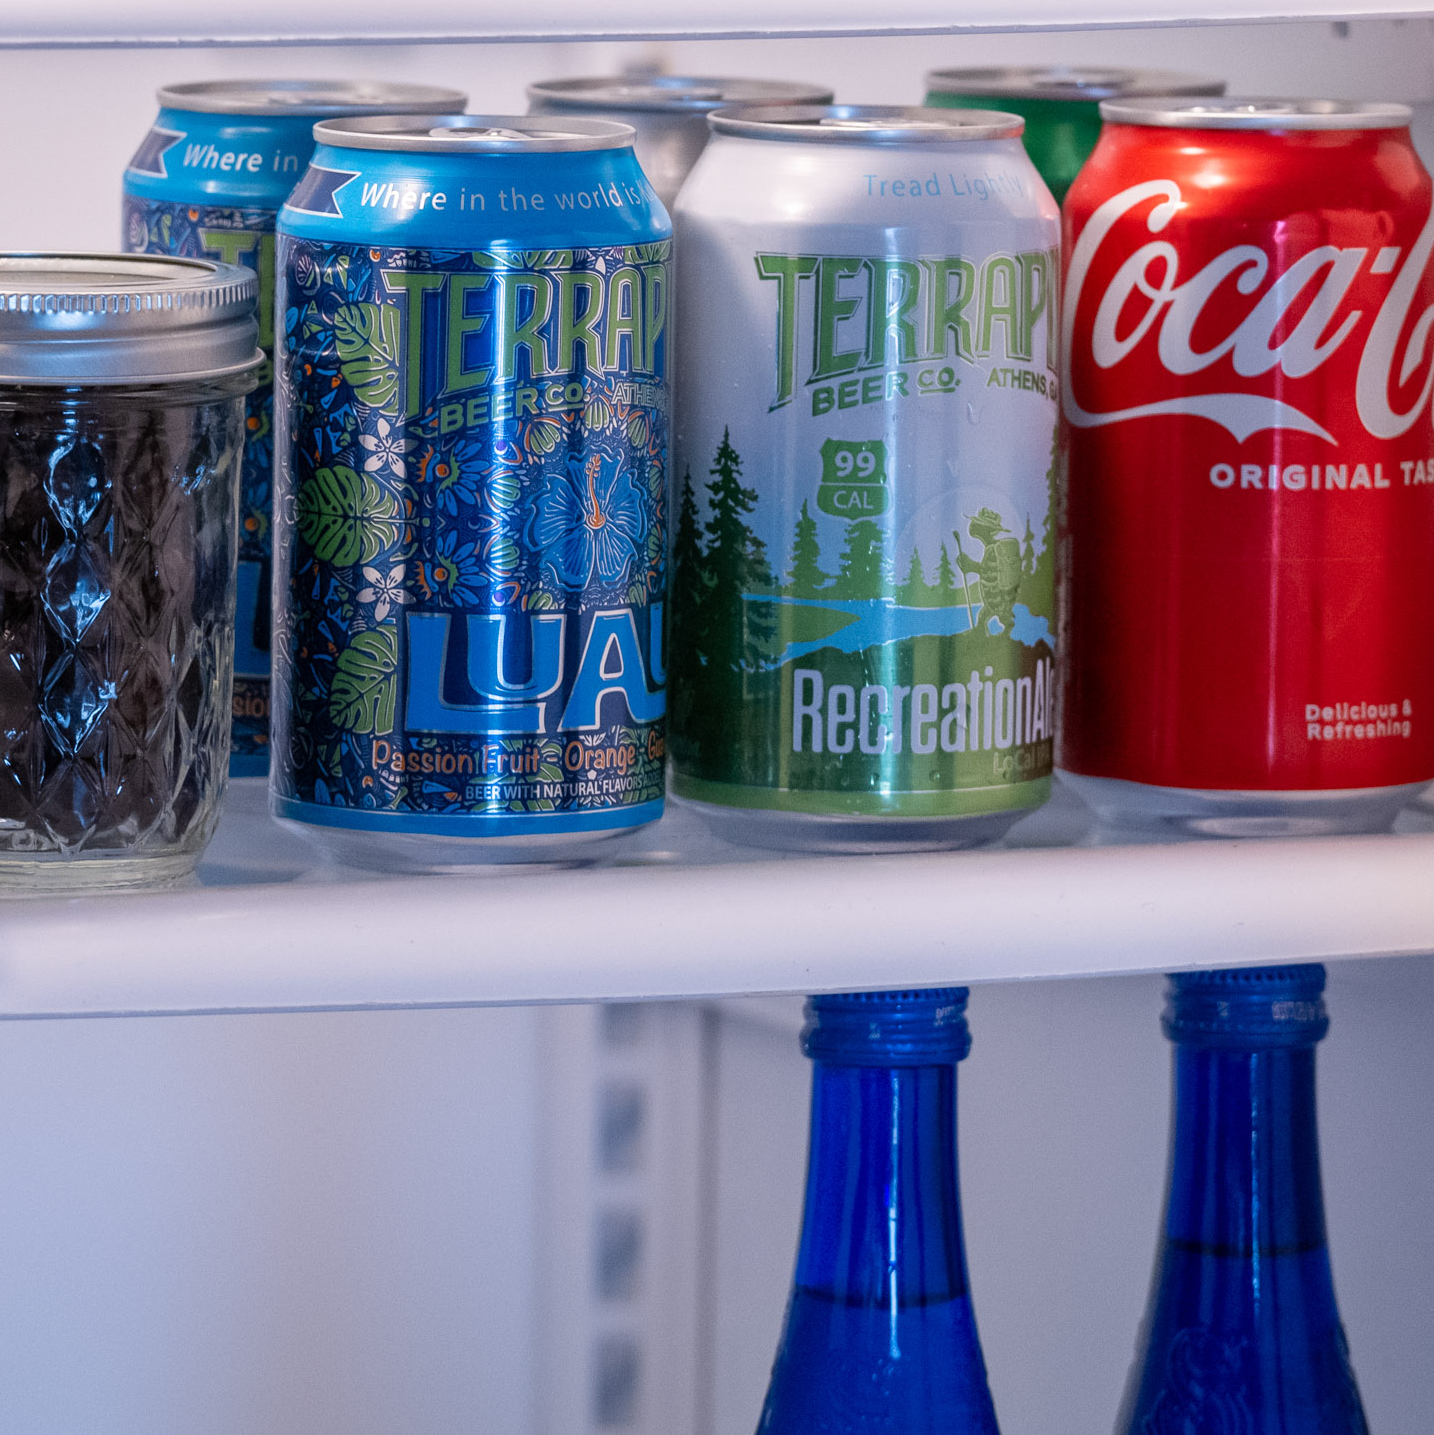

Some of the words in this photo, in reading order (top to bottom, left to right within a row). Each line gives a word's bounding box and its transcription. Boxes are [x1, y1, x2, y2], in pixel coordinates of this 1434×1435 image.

[182, 142, 263, 173] Where
[274, 148, 298, 173] in
[360, 182, 447, 212] Where
[460, 187, 485, 212] in
[498, 186, 545, 212] the
[554, 181, 624, 211] world
[624, 181, 640, 206] is
[862, 173, 941, 198] Tread
[949, 172, 1024, 201] Lightly
[812, 369, 910, 417] BEER
[440, 387, 538, 435] BEER
[833, 449, 877, 478] 99
[1209, 461, 1392, 492] ORIGINAL
[832, 490, 874, 510] CAL
[1304, 701, 1400, 722] Delicious
[1401, 698, 1413, 717] &
[1306, 719, 1411, 741] Refreshing
[371, 738, 473, 775] Passion
[481, 742, 541, 775] Fruit
[565, 740, 636, 775] Orange
[465, 785, 502, 801] BEER
[503, 785, 541, 800] WITH
[542, 779, 601, 799] NATURAL
[602, 774, 643, 794] FLAVORS
